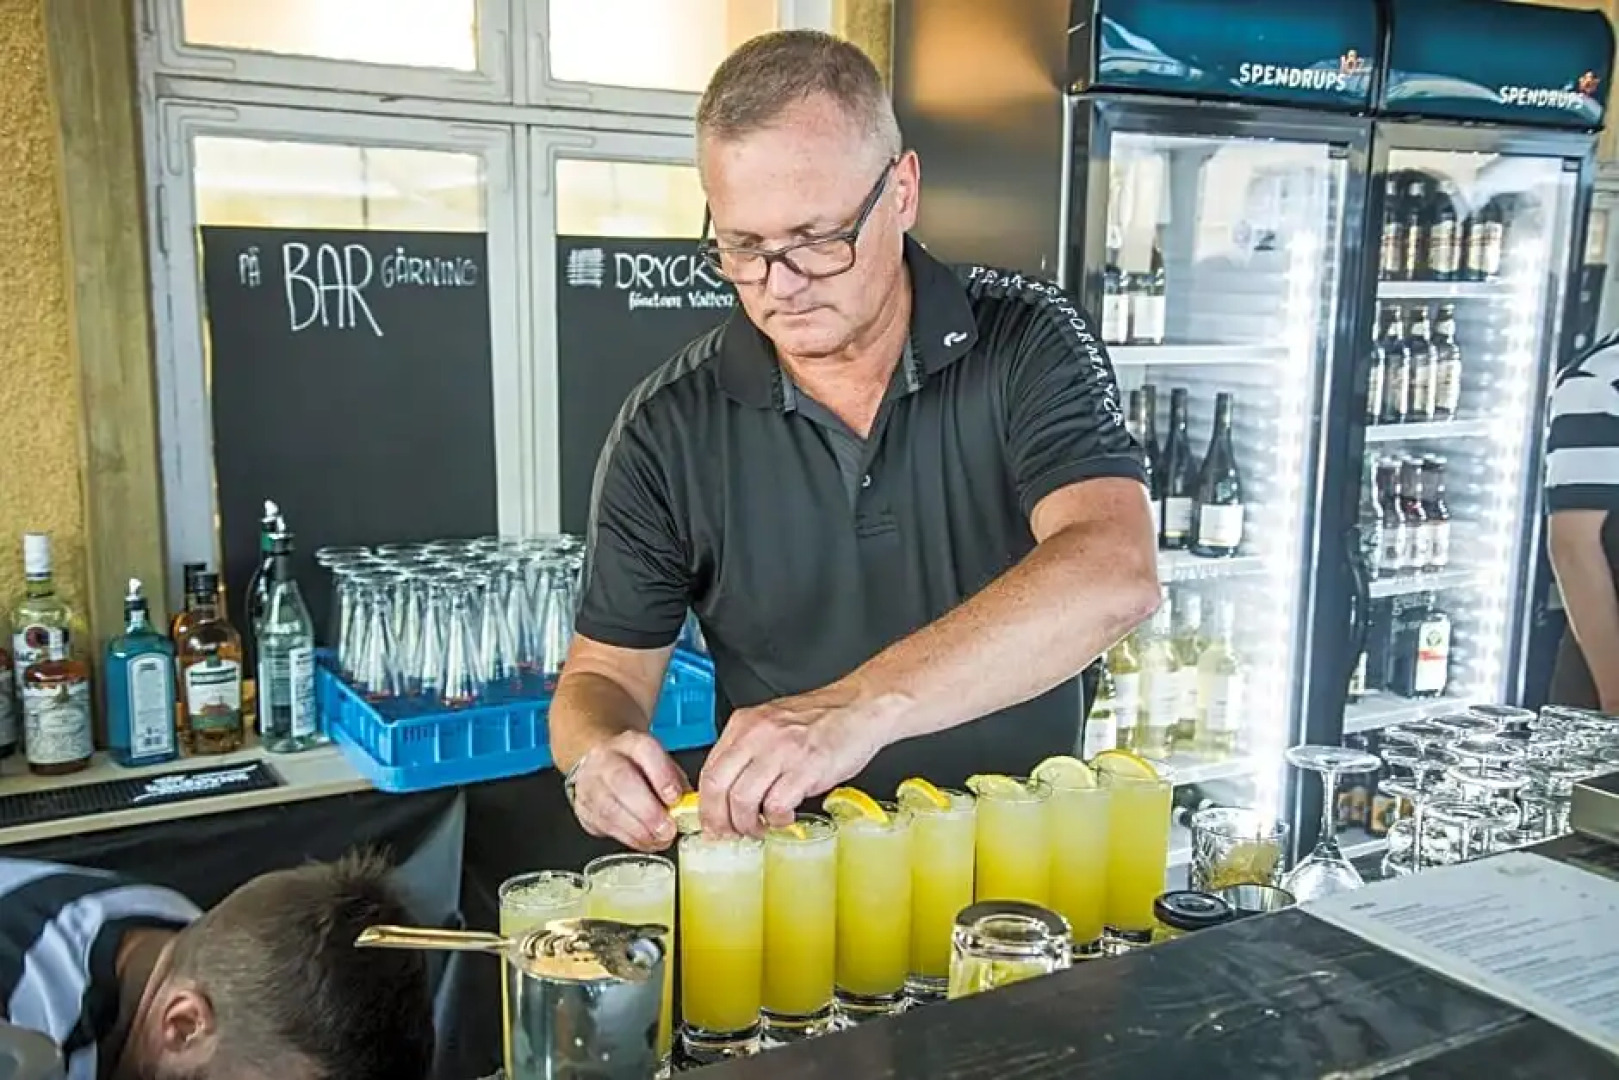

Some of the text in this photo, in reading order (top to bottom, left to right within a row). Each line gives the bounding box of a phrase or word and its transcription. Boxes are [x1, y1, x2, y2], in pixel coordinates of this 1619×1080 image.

[1239, 62, 1346, 92] SPENDRUPS
[1500, 85, 1583, 110] SPENDRUPS
[283, 242, 385, 338] BAR
